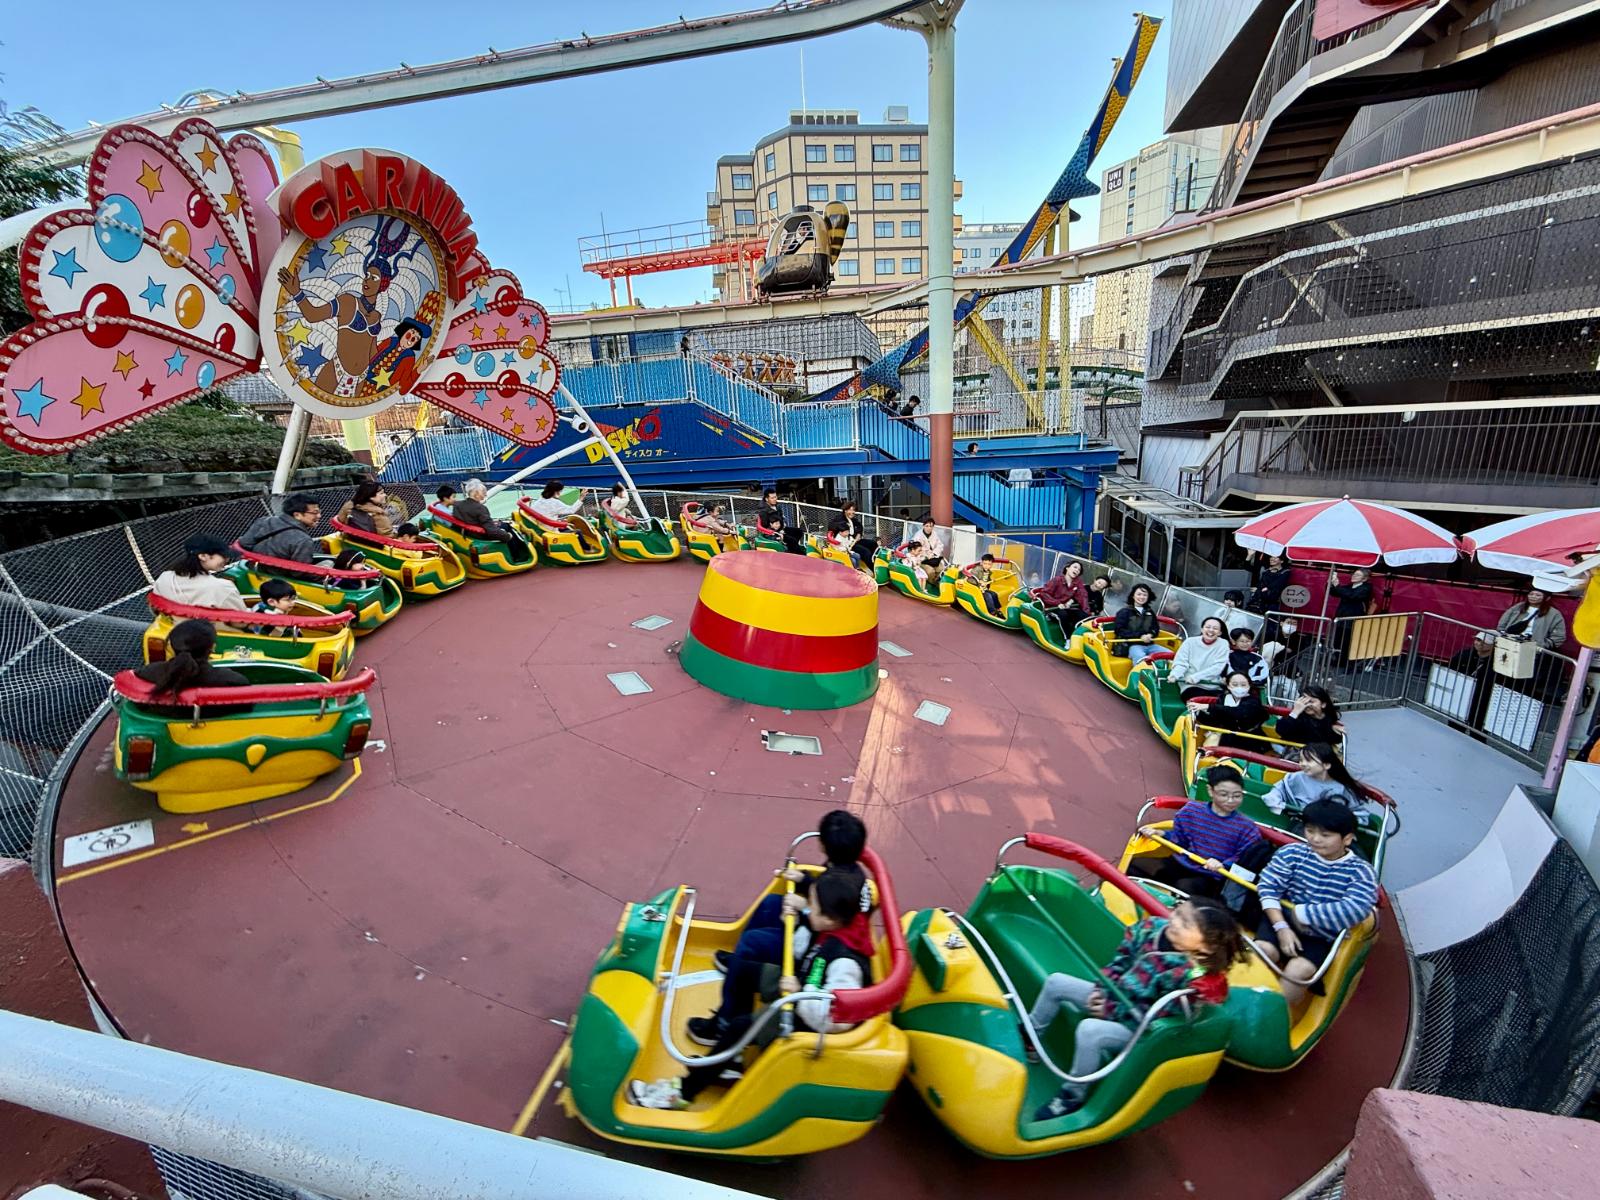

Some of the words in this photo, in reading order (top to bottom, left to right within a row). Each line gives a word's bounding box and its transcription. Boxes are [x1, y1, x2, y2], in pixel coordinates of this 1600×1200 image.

[1108, 169, 1122, 182] UNI
[1108, 178, 1122, 190] QLO
[284, 152, 484, 302] CARNIVAL
[624, 449, 653, 458] ディスク
